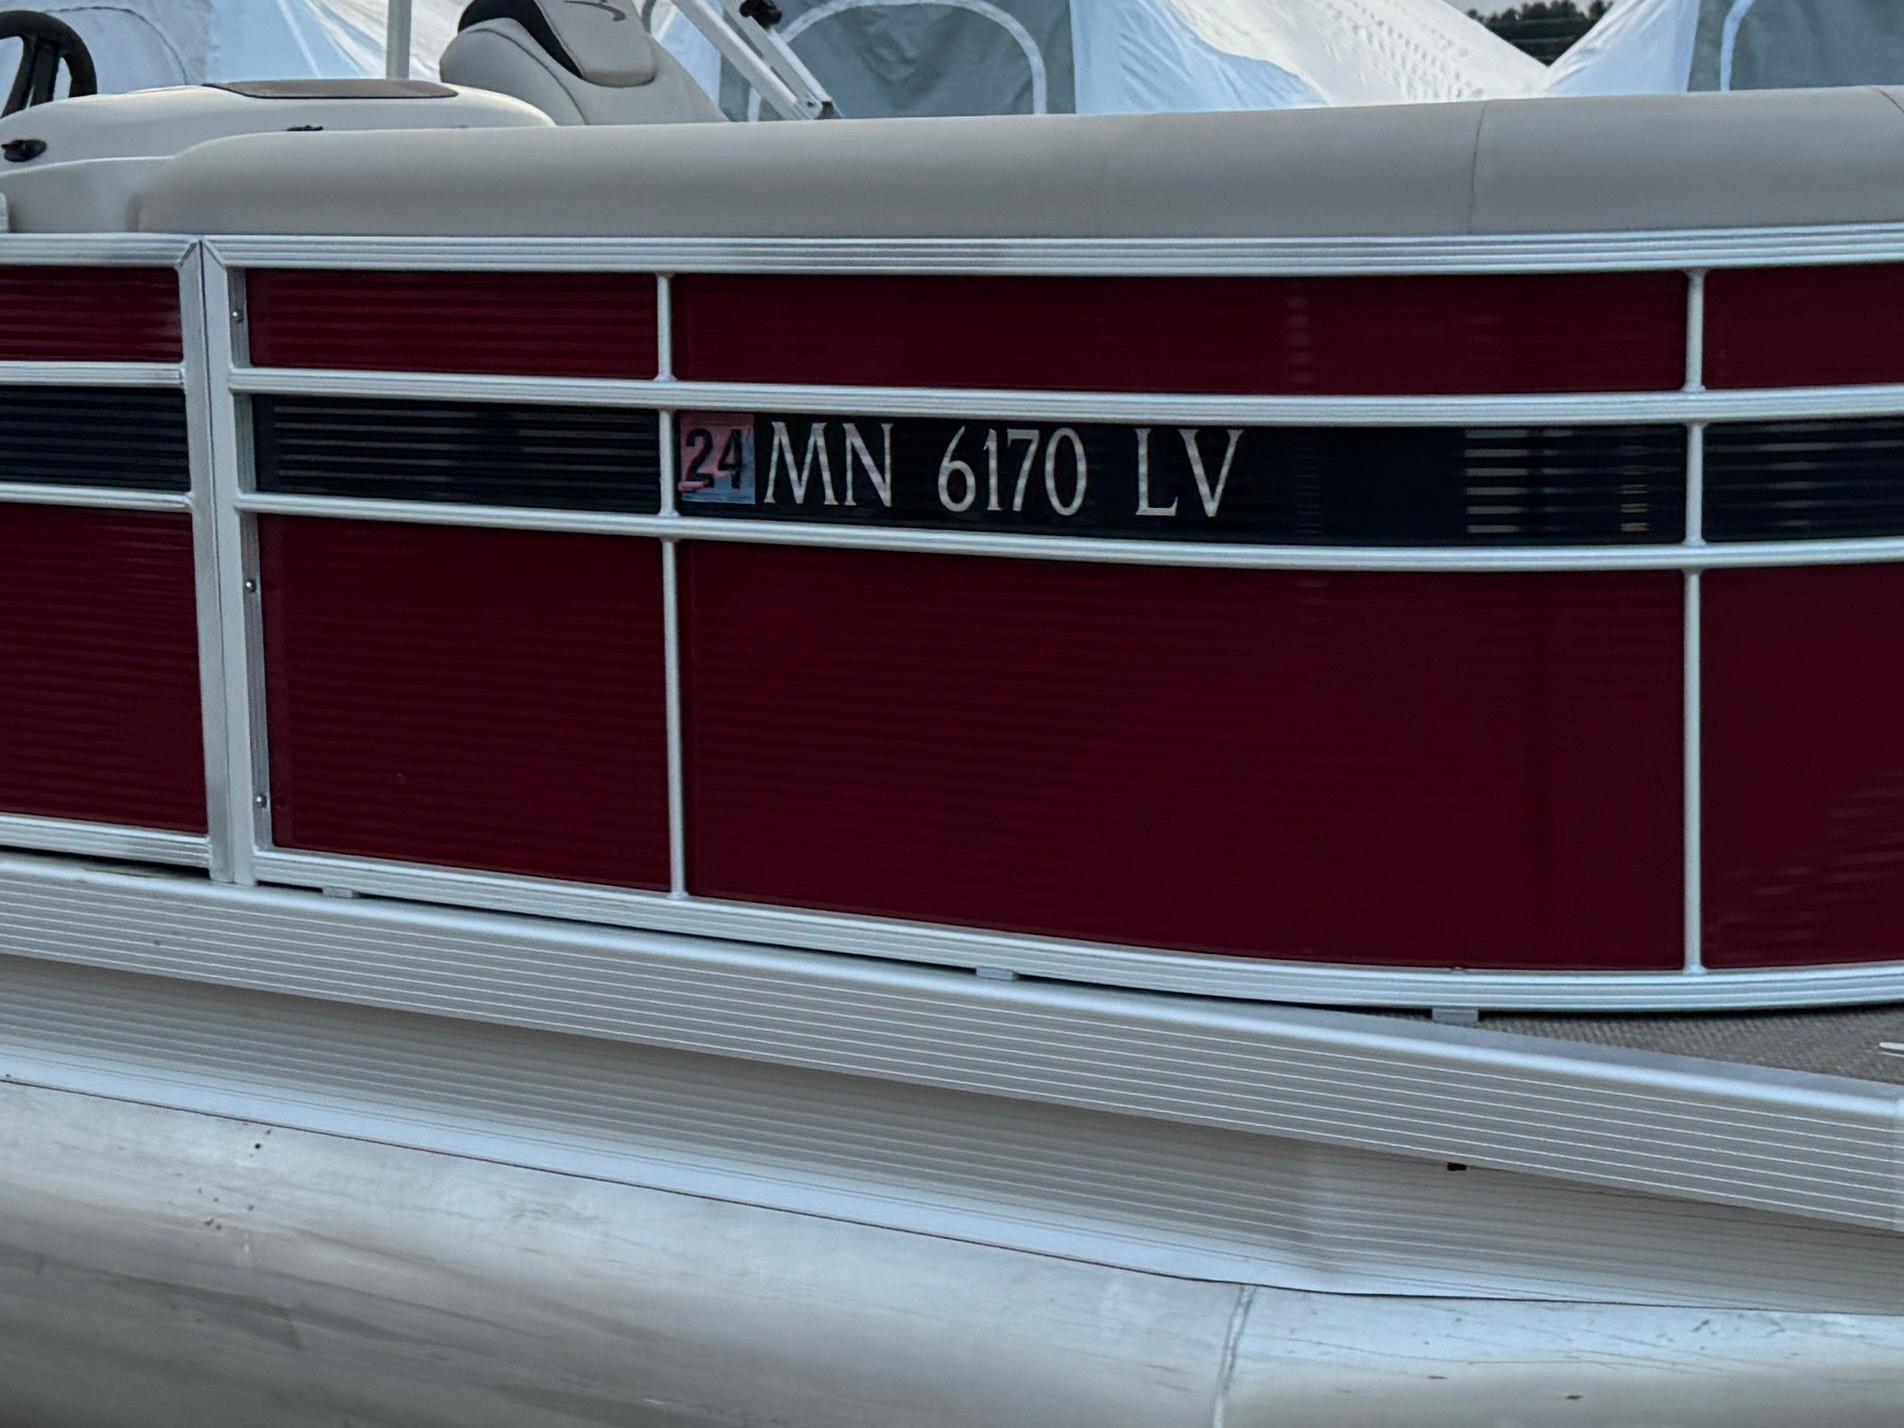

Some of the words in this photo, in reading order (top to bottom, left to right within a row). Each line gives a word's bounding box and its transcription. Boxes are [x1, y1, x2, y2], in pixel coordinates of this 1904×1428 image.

[685, 427, 745, 490] 24
[763, 420, 895, 508] MN
[937, 425, 1088, 516] 6170
[1134, 427, 1245, 518] LV
